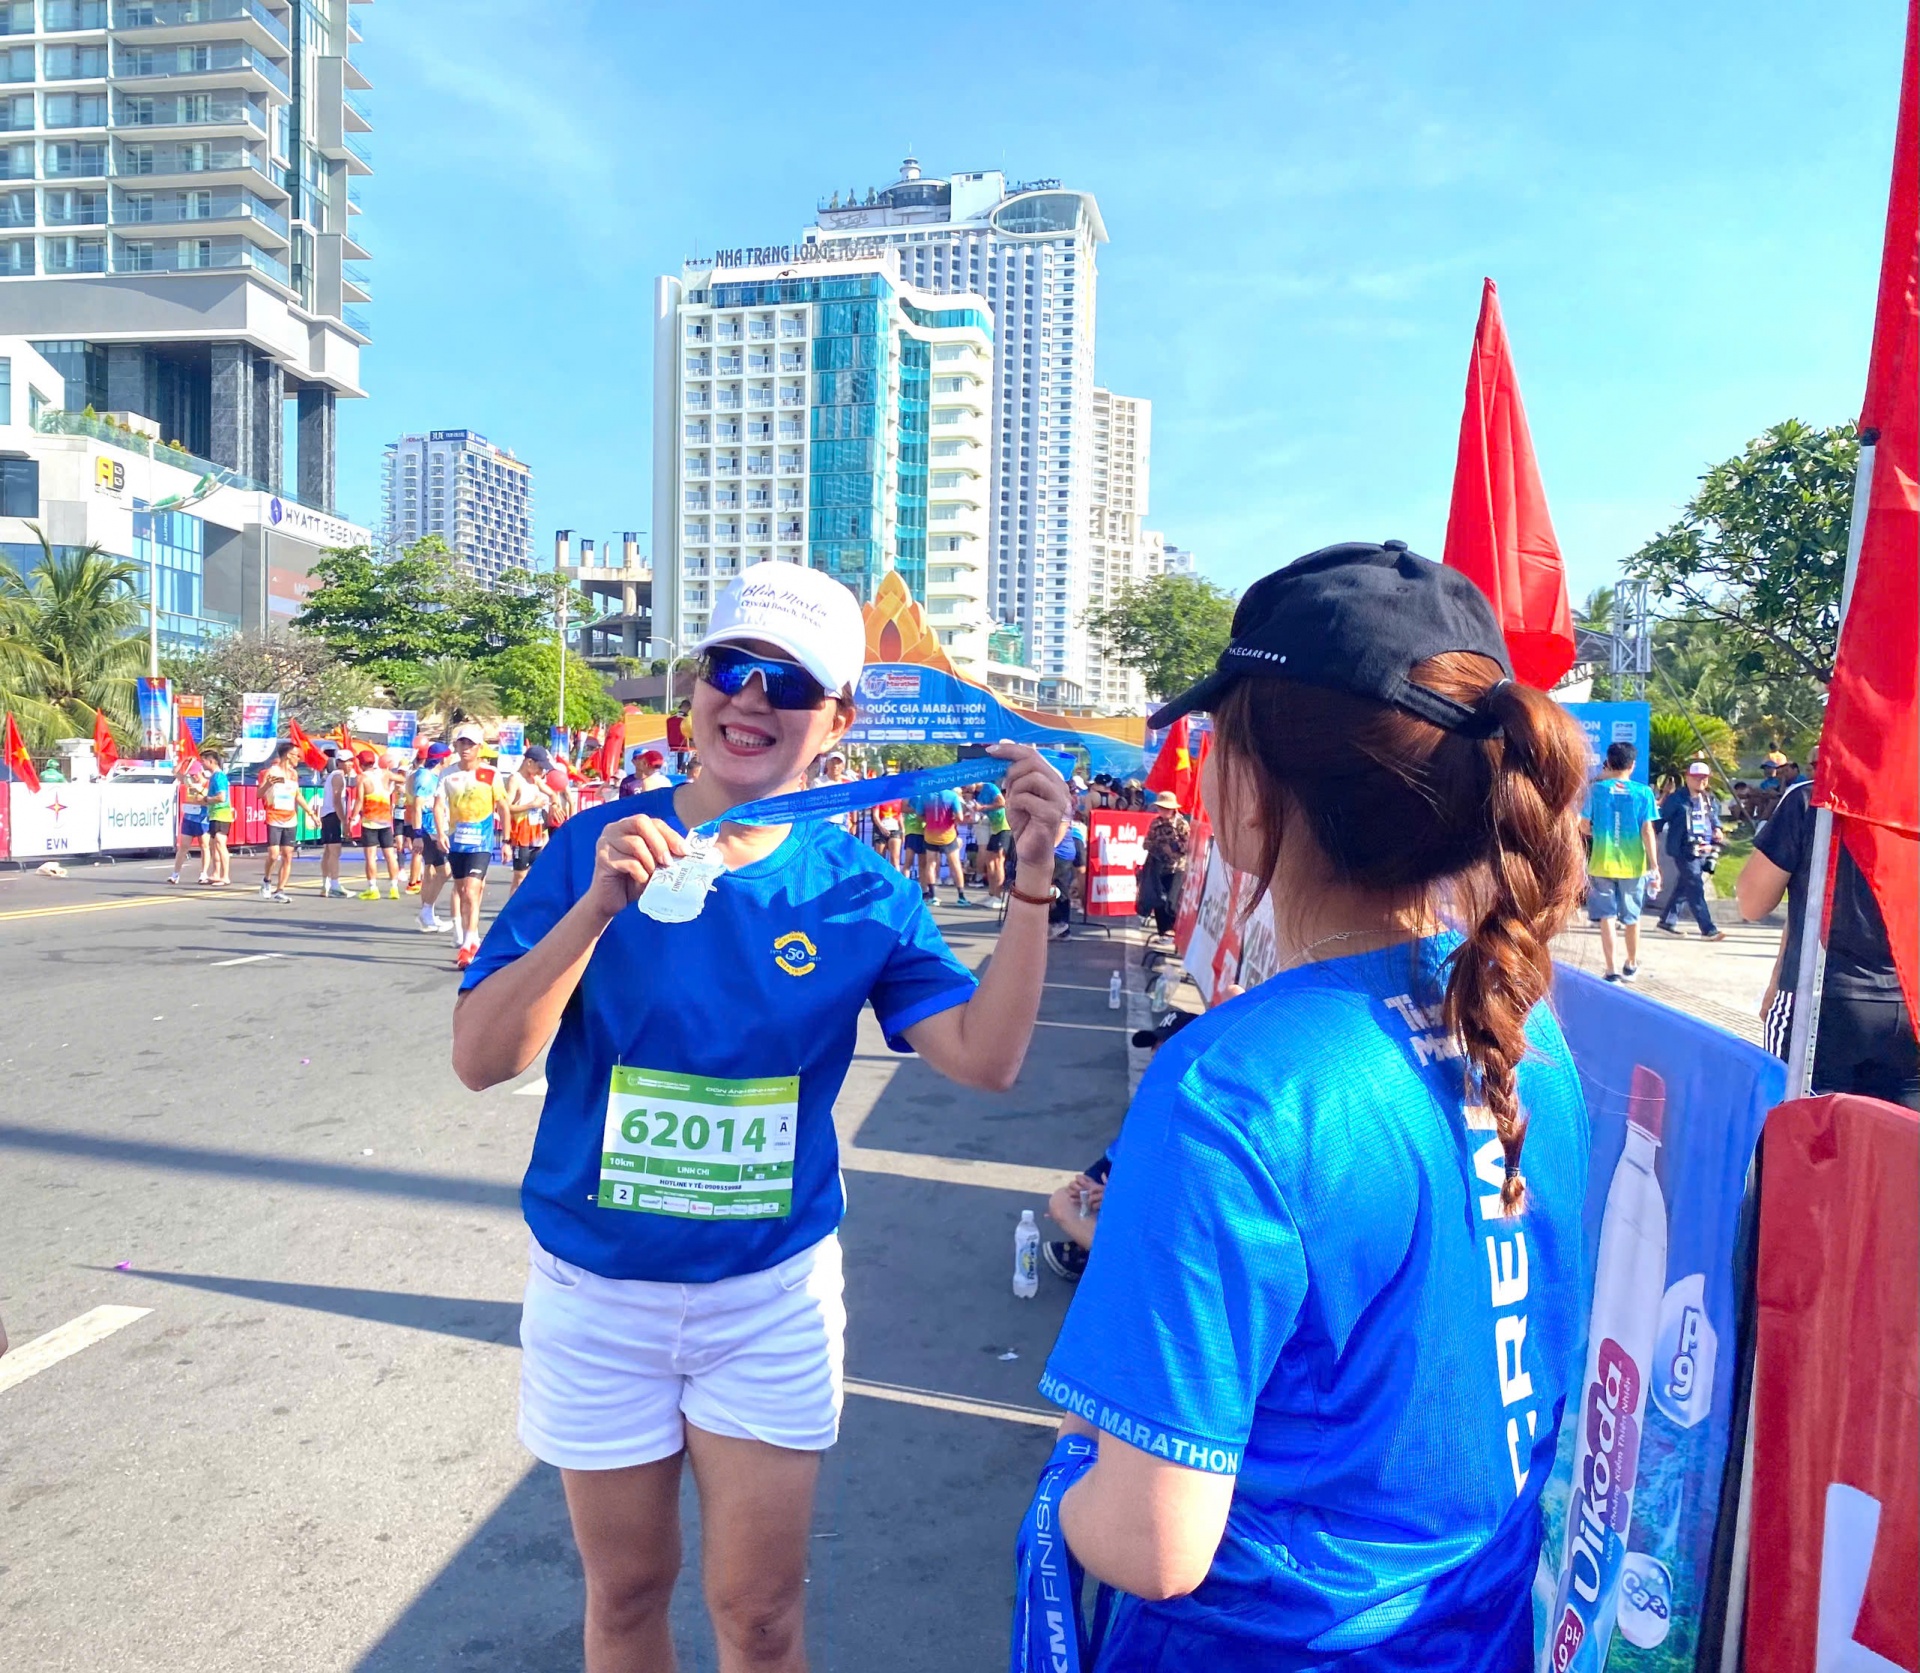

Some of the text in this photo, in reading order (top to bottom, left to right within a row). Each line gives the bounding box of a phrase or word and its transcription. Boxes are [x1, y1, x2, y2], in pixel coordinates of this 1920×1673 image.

[715, 237, 885, 268] NHA TRANG LODGE HOTEL
[285, 507, 370, 545] HYATT REGENCY
[867, 700, 898, 715] QUỐC
[900, 703, 920, 714] GIA
[922, 703, 987, 714] MARATHON
[918, 716, 930, 725] 67
[963, 716, 987, 725] 2026
[108, 807, 165, 828] Herbalife
[46, 838, 68, 850] EVN
[785, 947, 805, 961] 50
[621, 1108, 767, 1153] 62014
[780, 1121, 788, 1133] A
[609, 1156, 635, 1168] 10km
[677, 1166, 710, 1176] LINH CHI
[659, 1179, 688, 1188] HOTLINE
[619, 1189, 627, 1200] 2
[1463, 1105, 1538, 1499] CREW
[1099, 1405, 1239, 1474] MARATHON
